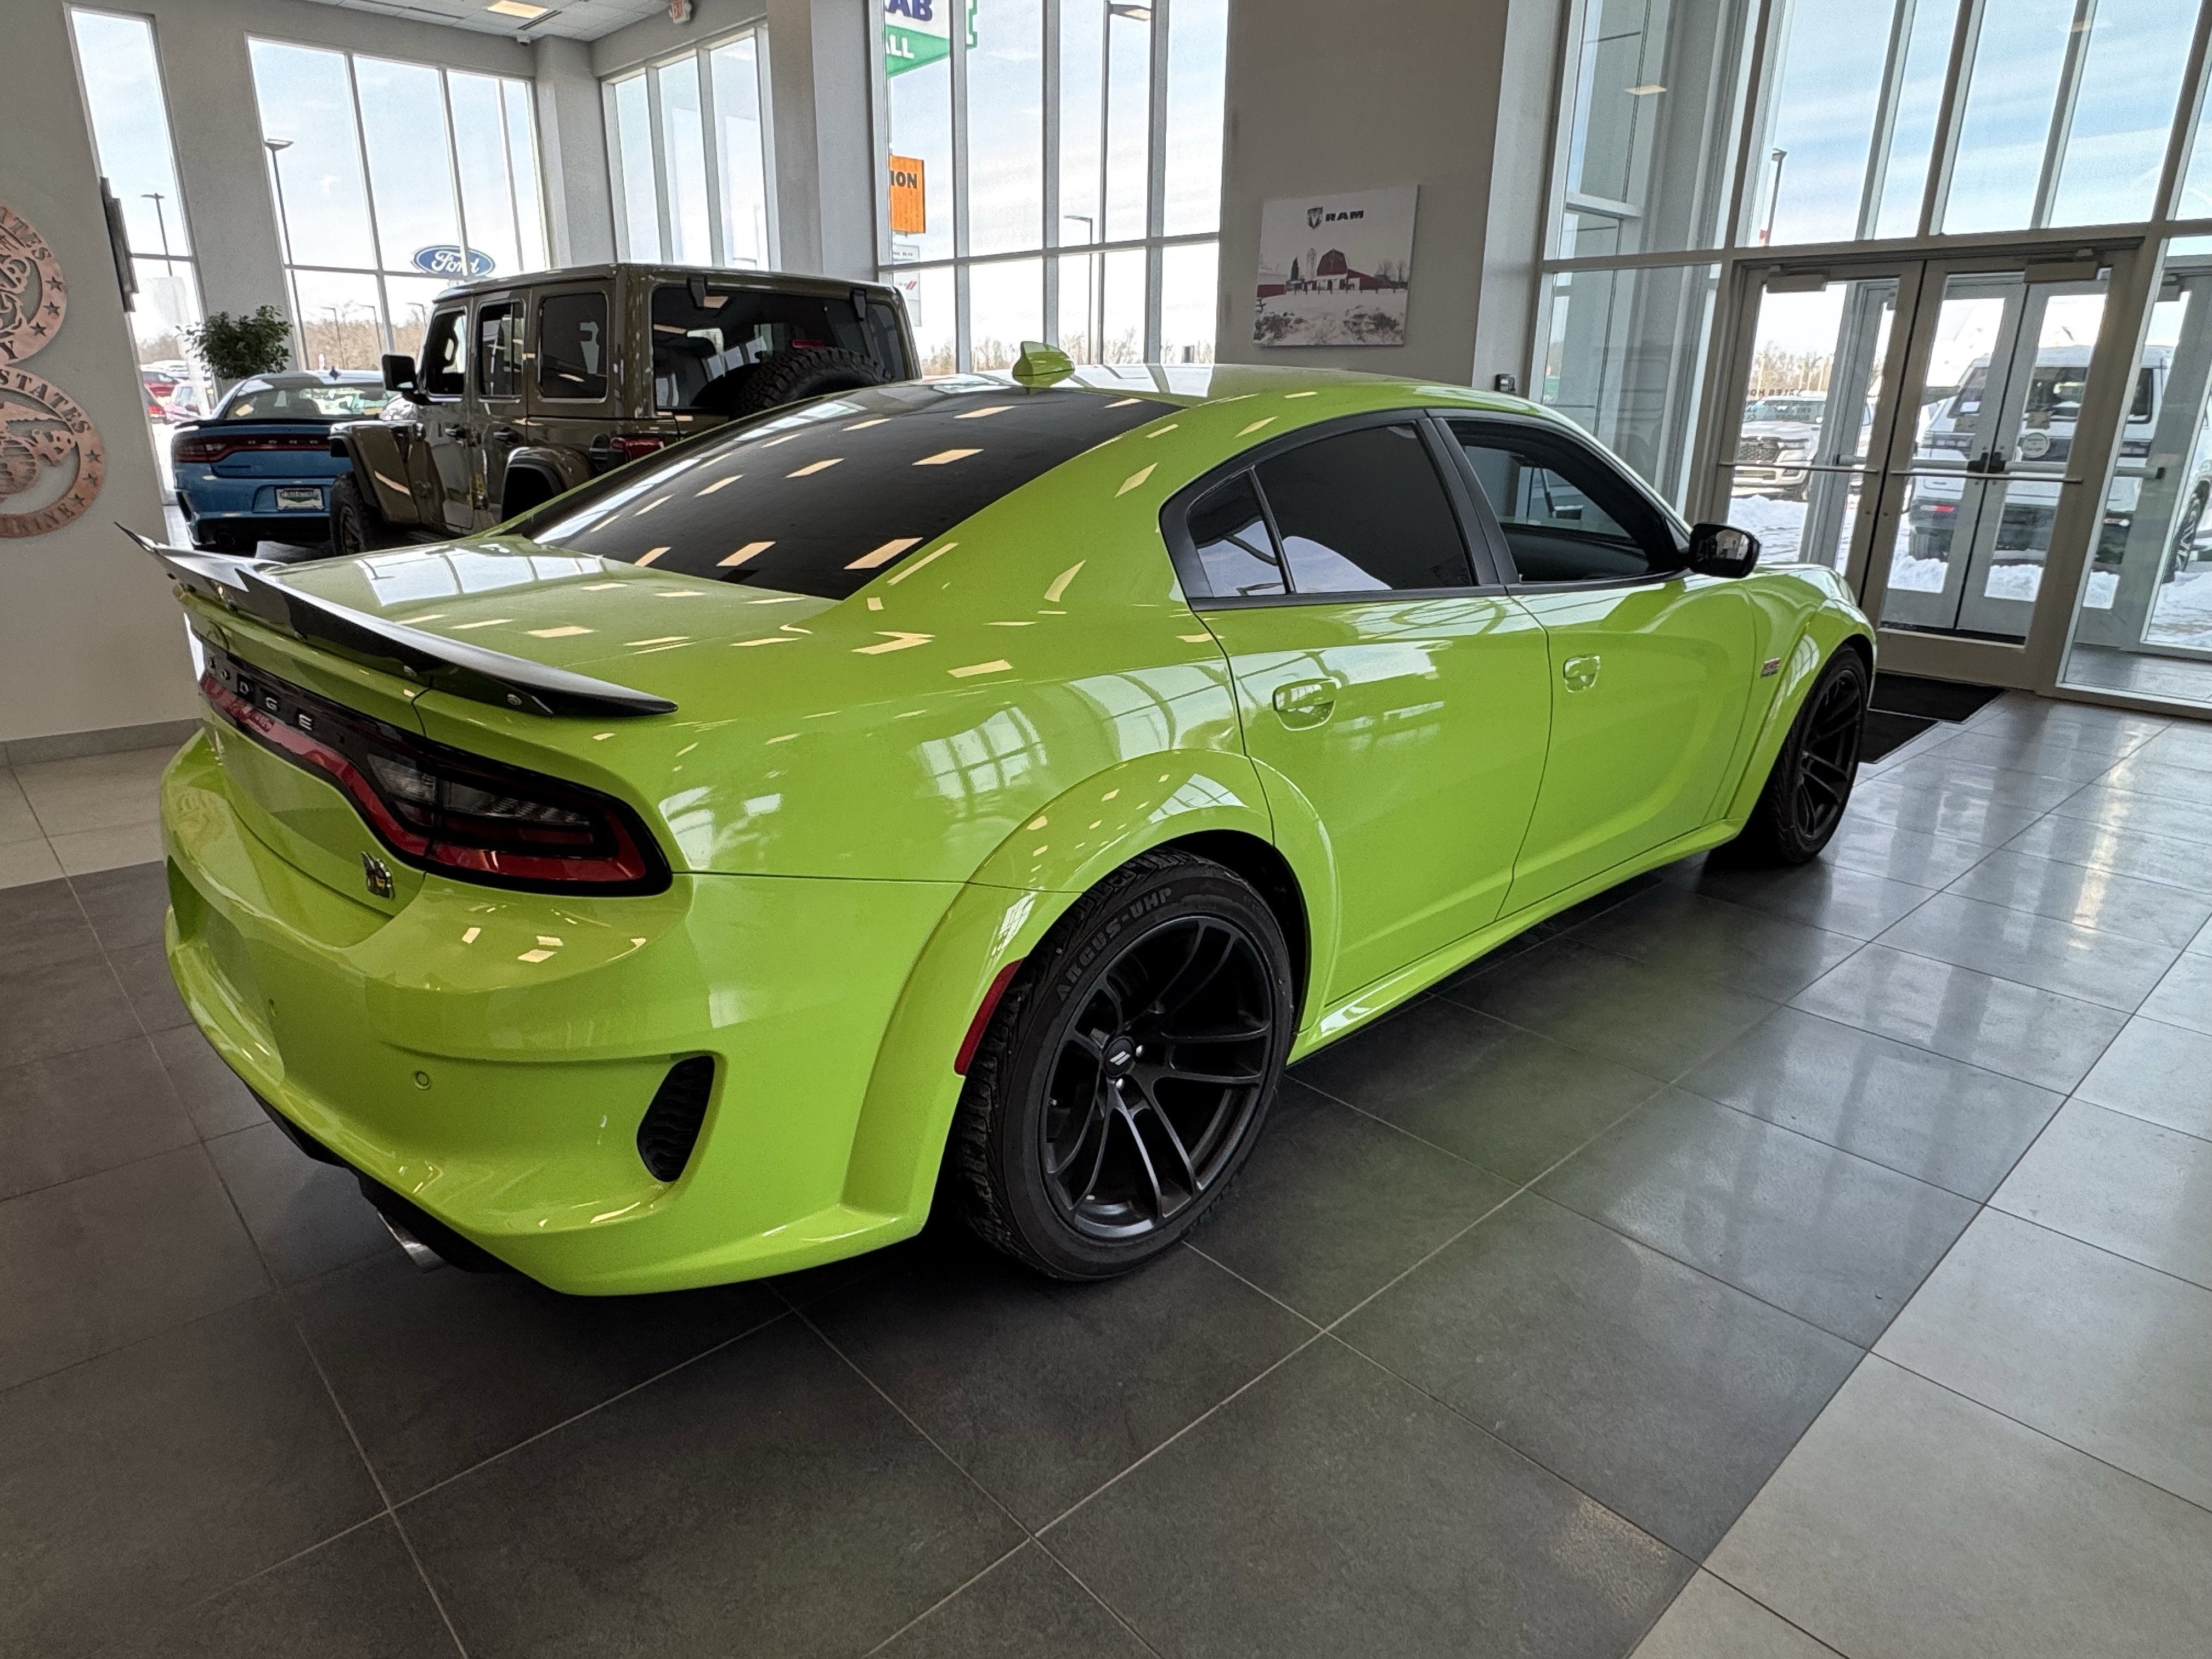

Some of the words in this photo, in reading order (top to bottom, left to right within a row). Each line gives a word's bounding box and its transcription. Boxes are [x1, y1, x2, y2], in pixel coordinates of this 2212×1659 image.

[884, 0, 933, 21] AB
[1325, 210, 1364, 222] RAM
[0, 369, 91, 433] STATES
[208, 656, 313, 731] DODGE
